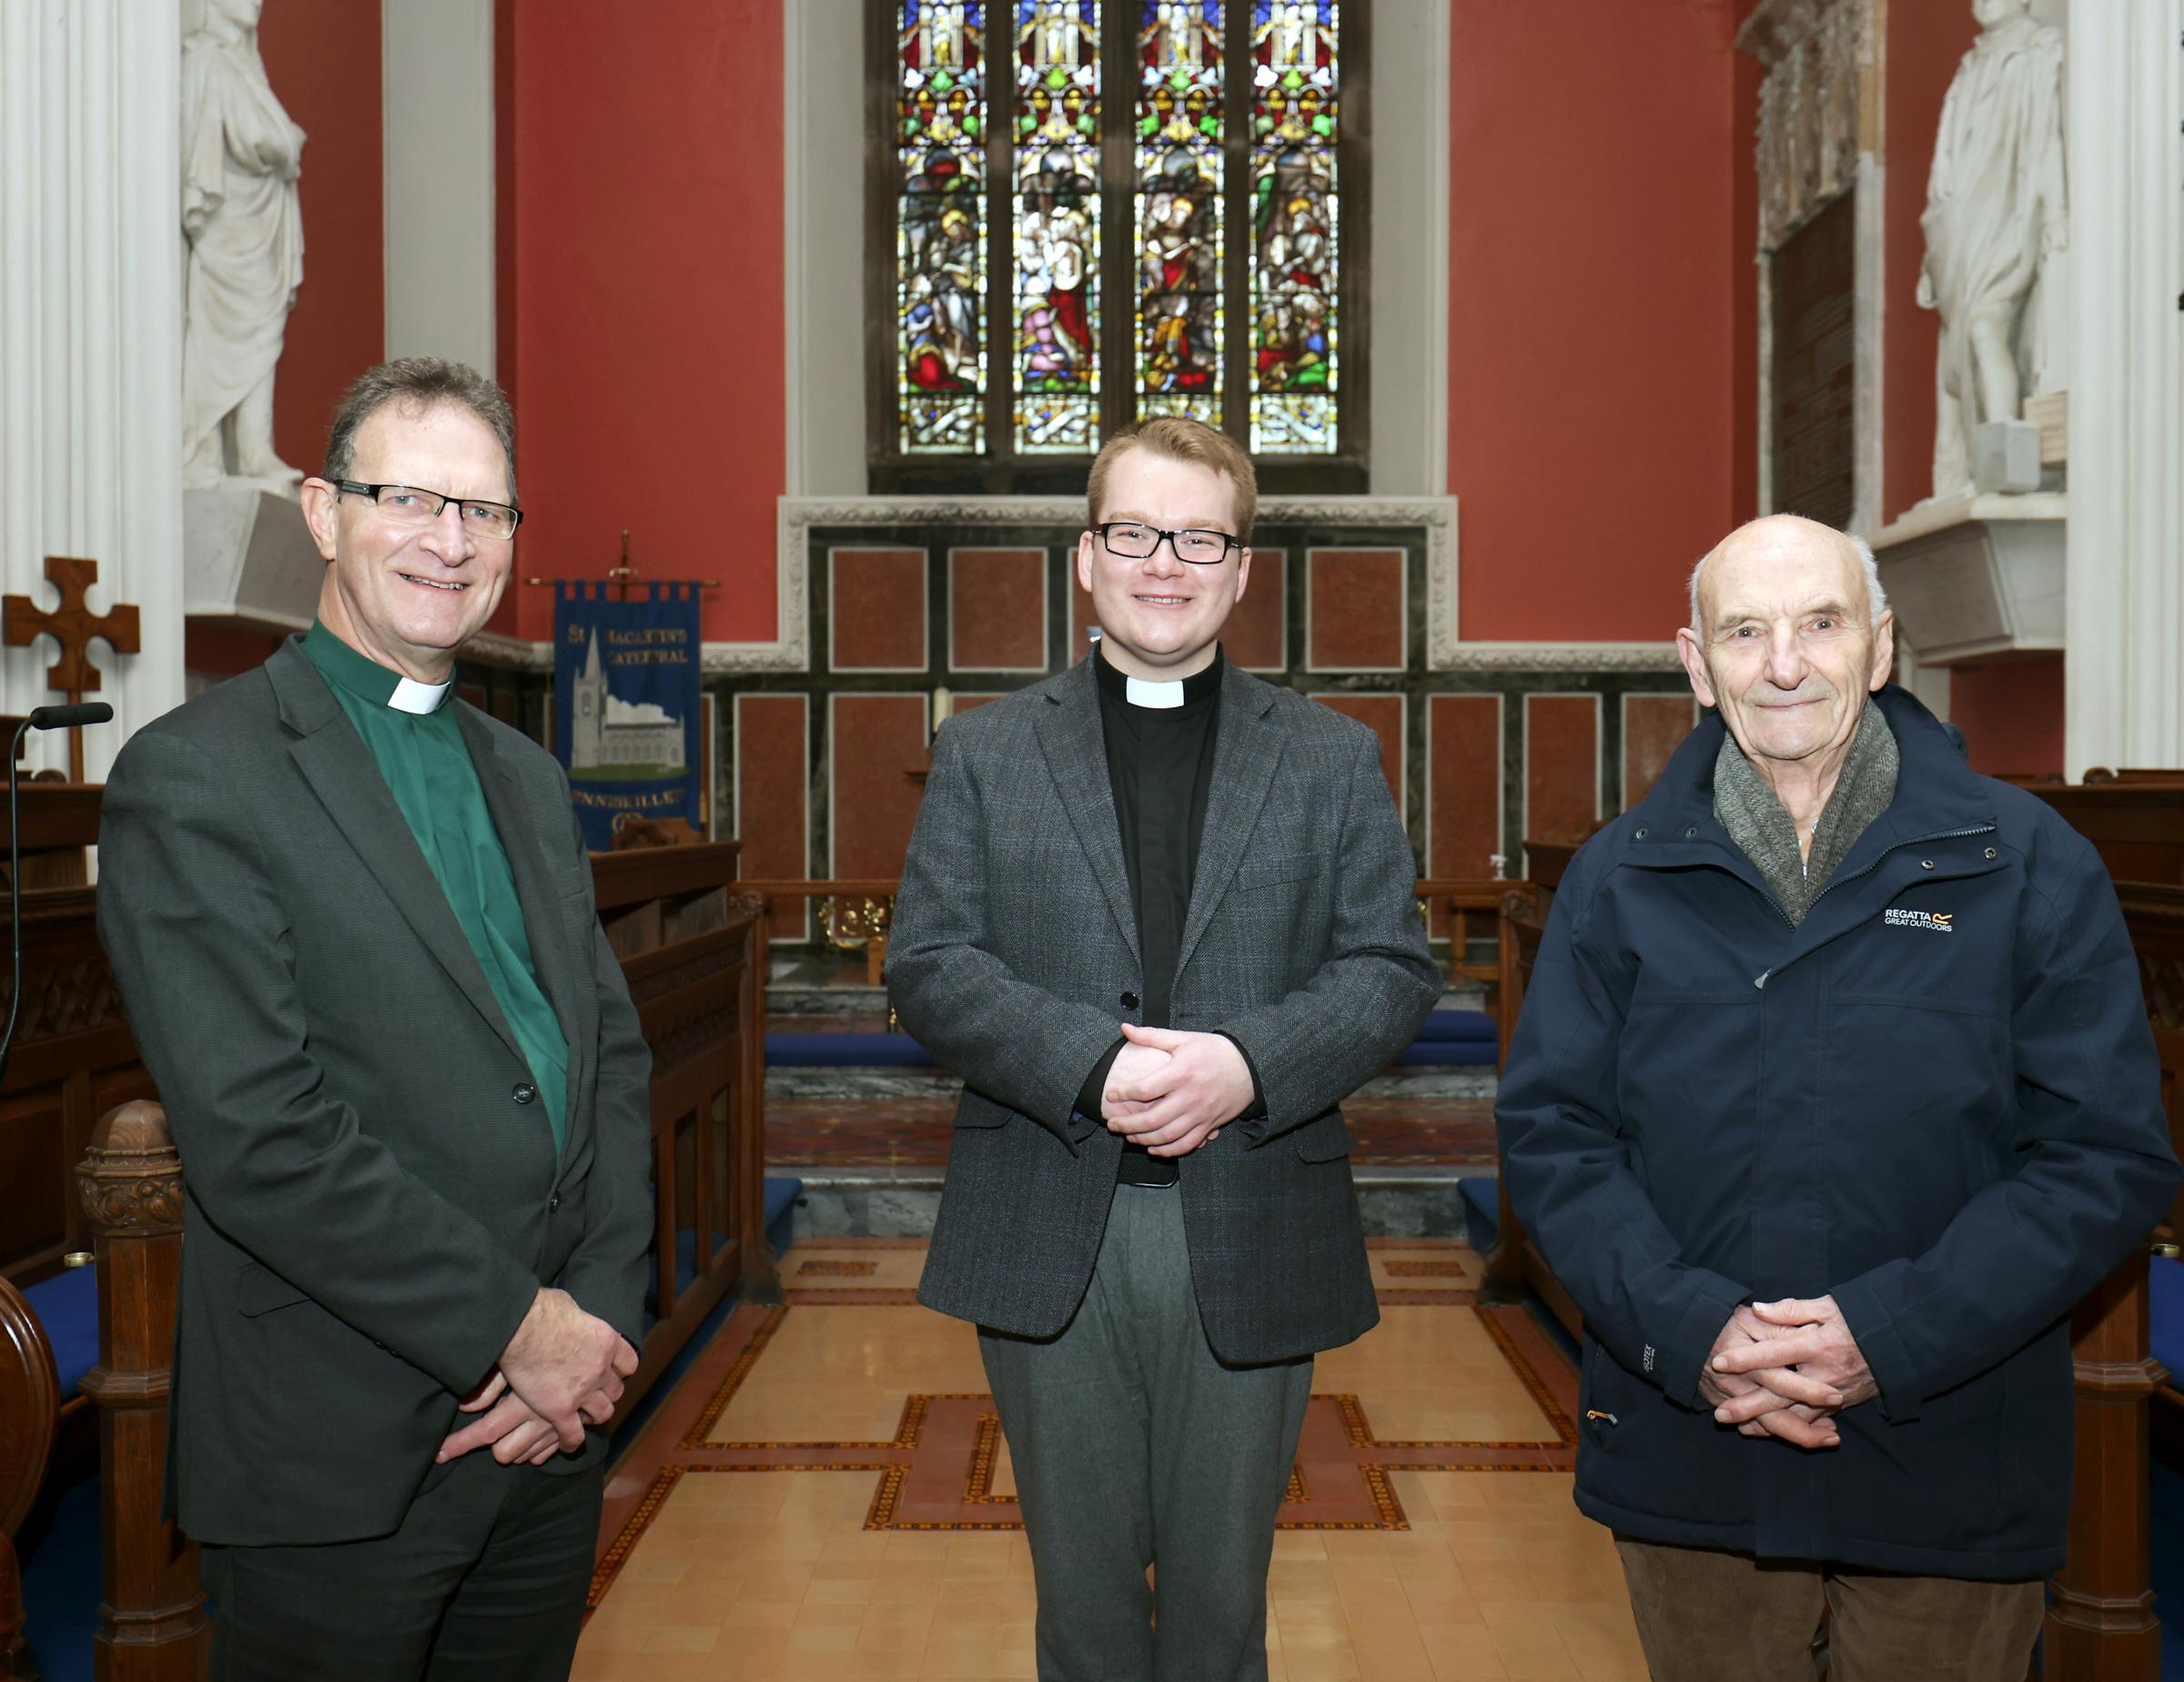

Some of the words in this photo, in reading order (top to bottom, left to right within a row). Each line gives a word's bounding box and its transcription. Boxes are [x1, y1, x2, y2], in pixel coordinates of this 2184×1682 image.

[569, 624, 584, 643] St
[1886, 909, 1931, 921] REGATTA
[1885, 917, 1909, 926] GREAT
[1910, 919, 1952, 932] OUTDOORS
